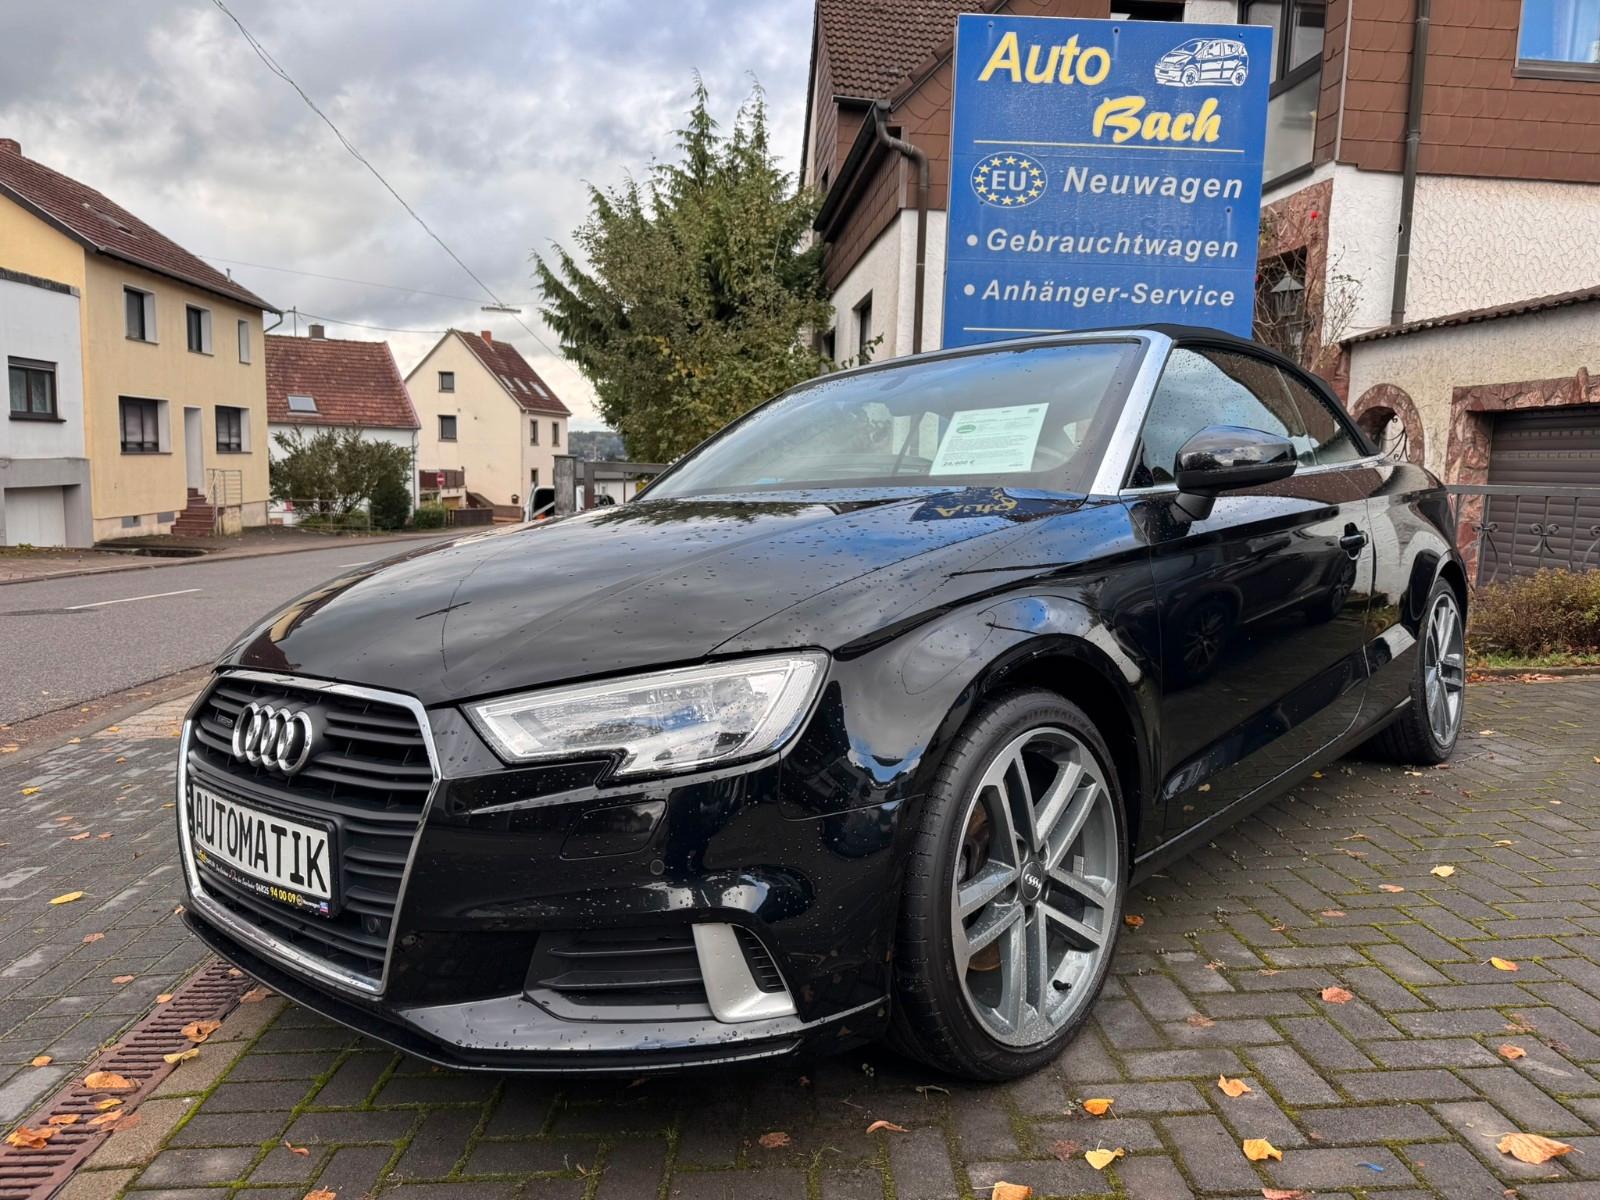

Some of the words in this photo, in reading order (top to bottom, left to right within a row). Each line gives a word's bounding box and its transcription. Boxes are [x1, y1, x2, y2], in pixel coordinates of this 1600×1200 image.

[977, 31, 1111, 86] Auto
[1092, 95, 1222, 143] Bach
[991, 170, 1026, 191] EU
[1063, 166, 1243, 203] Neuwagen
[986, 228, 1239, 262] Gebrauchtwagen
[982, 279, 1235, 308] Anhänger-Service
[196, 791, 328, 893] AUTOMATIK
